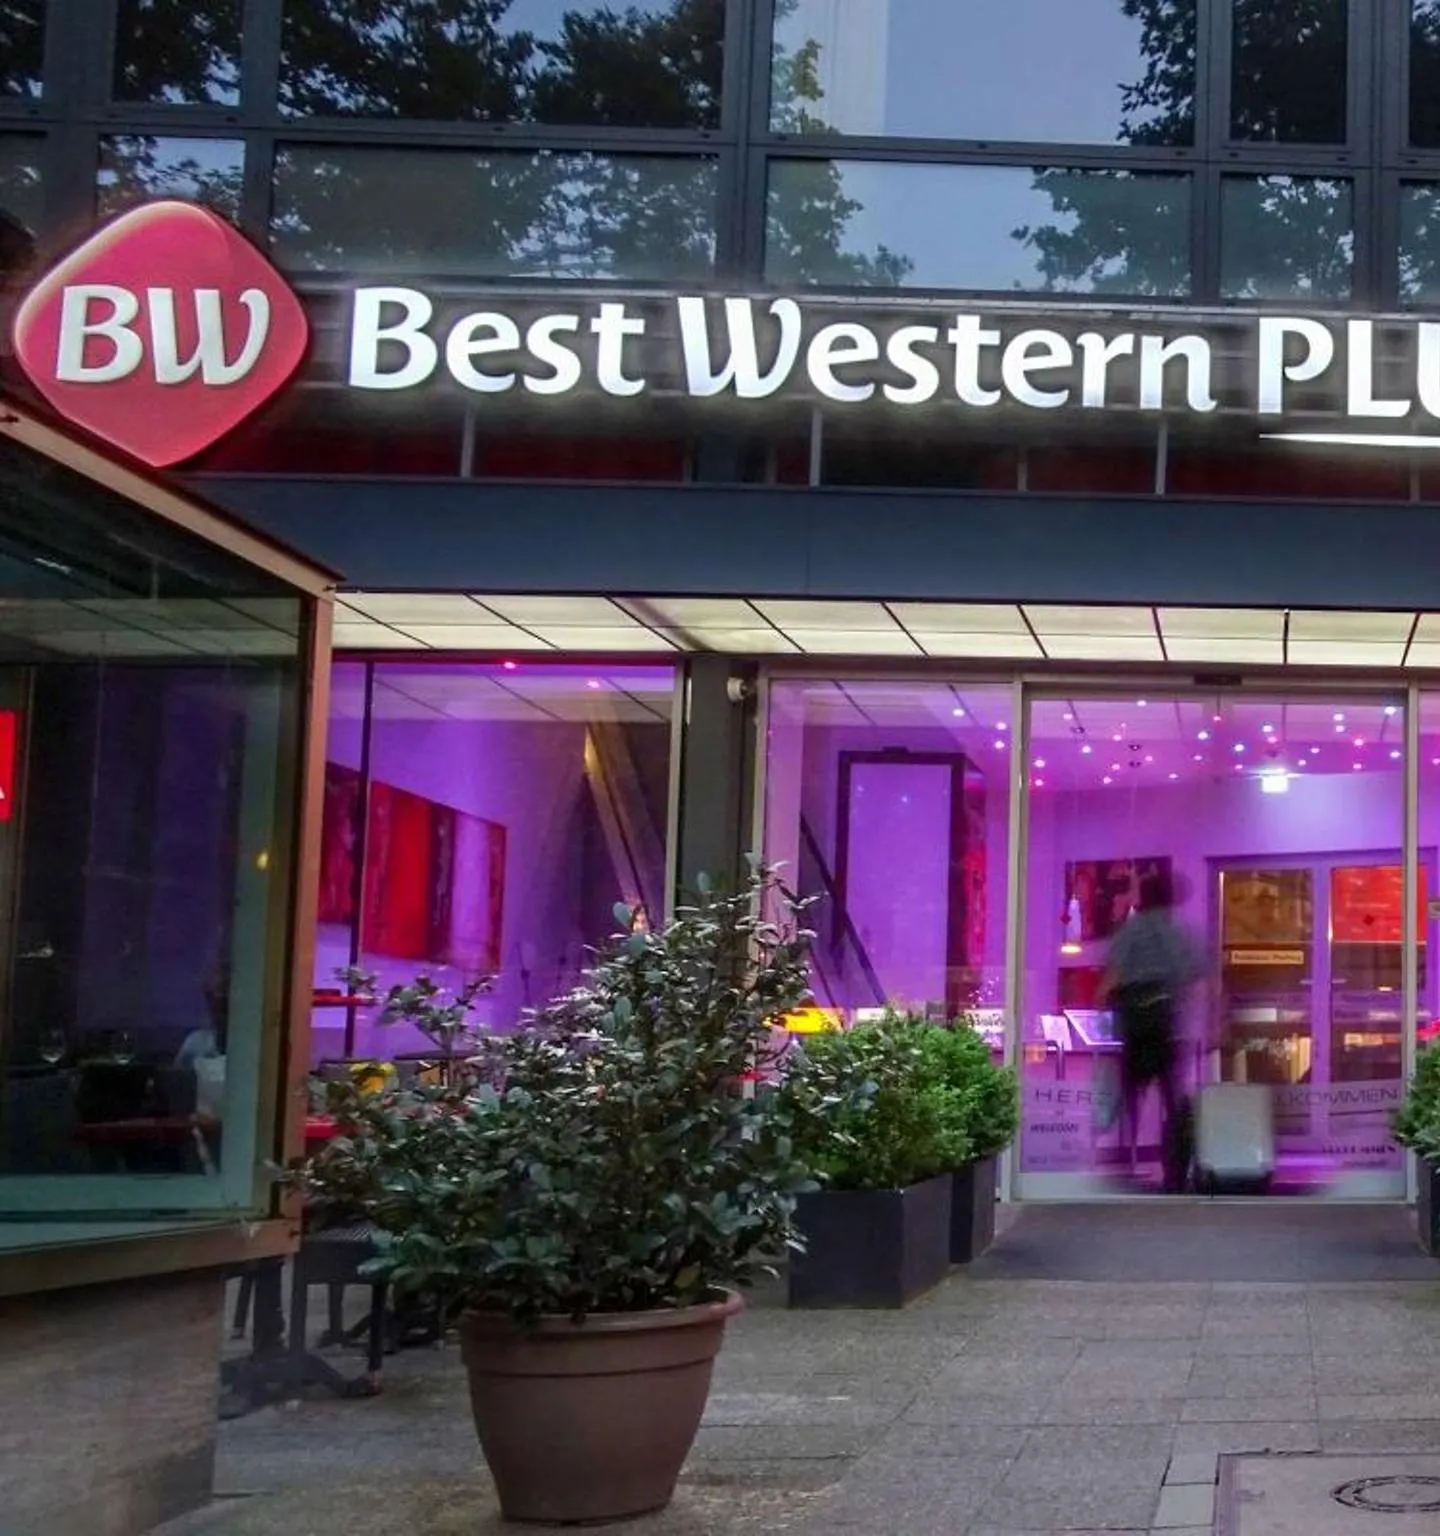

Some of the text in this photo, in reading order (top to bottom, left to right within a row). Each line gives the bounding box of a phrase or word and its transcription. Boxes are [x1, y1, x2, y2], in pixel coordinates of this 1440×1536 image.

[56, 284, 270, 387] BW
[349, 287, 645, 397] Best
[676, 295, 1218, 411] Western
